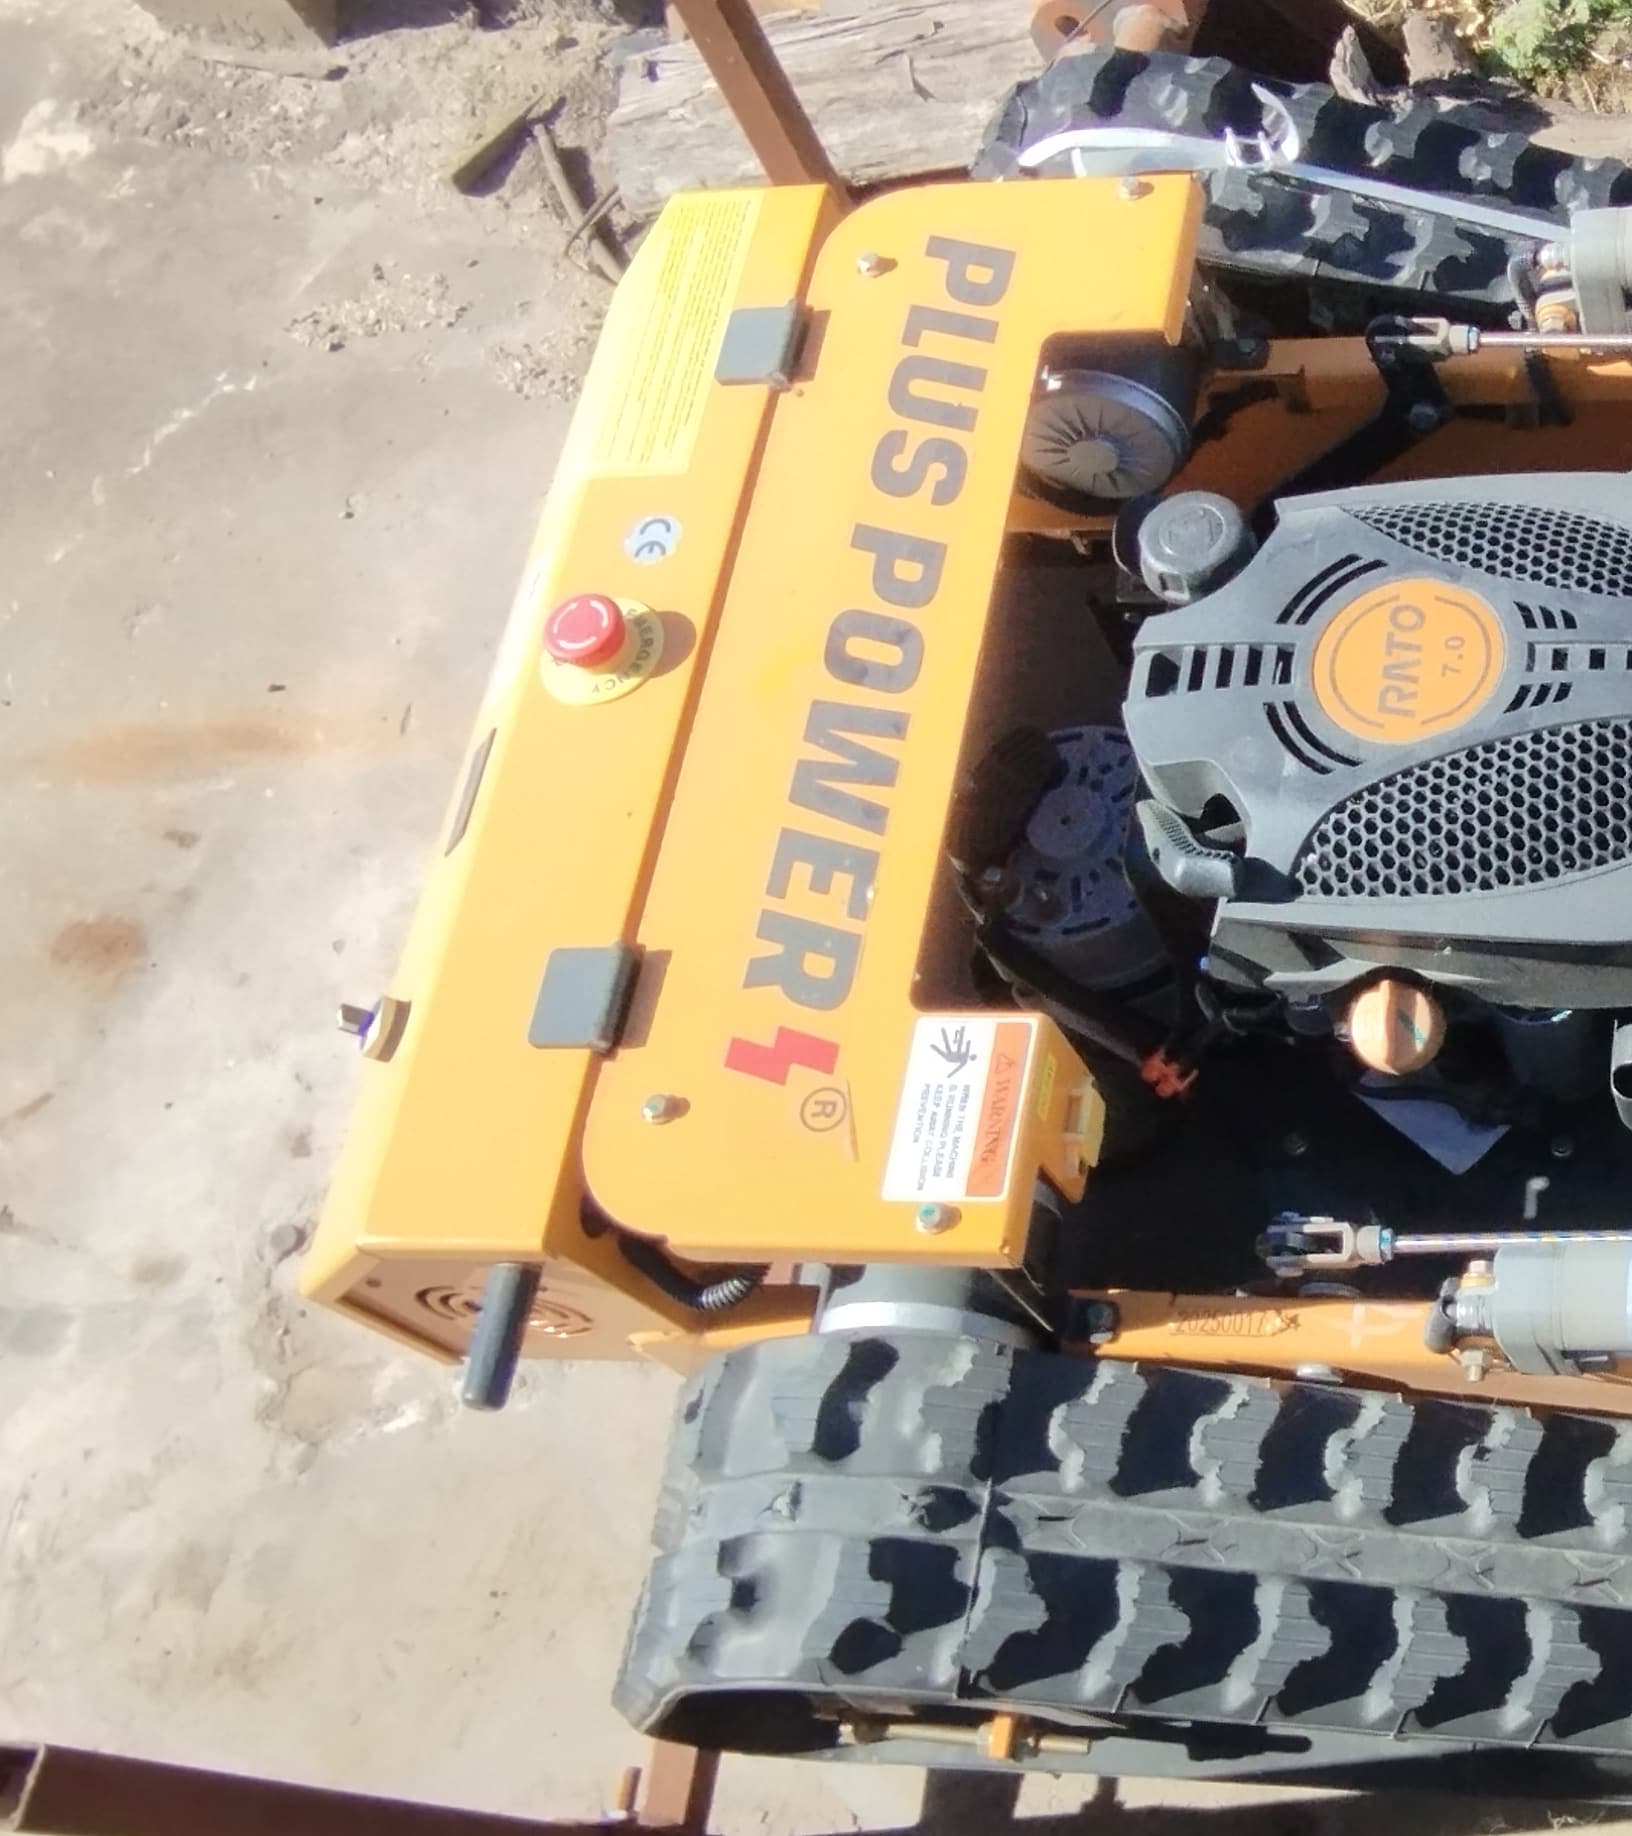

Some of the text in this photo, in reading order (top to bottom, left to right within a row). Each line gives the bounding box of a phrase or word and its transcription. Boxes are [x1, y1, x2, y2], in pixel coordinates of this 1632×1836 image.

[871, 234, 1016, 507] PLUS
[634, 518, 671, 558] CE
[1377, 603, 1426, 718] RATO
[1441, 635, 1466, 678] 7.0
[743, 523, 948, 1012] POWER
[933, 1084, 944, 1108] KEEP
[956, 1114, 967, 1134] THE
[981, 1079, 1011, 1163] WARNING
[933, 1139, 948, 1178] PLEASE
